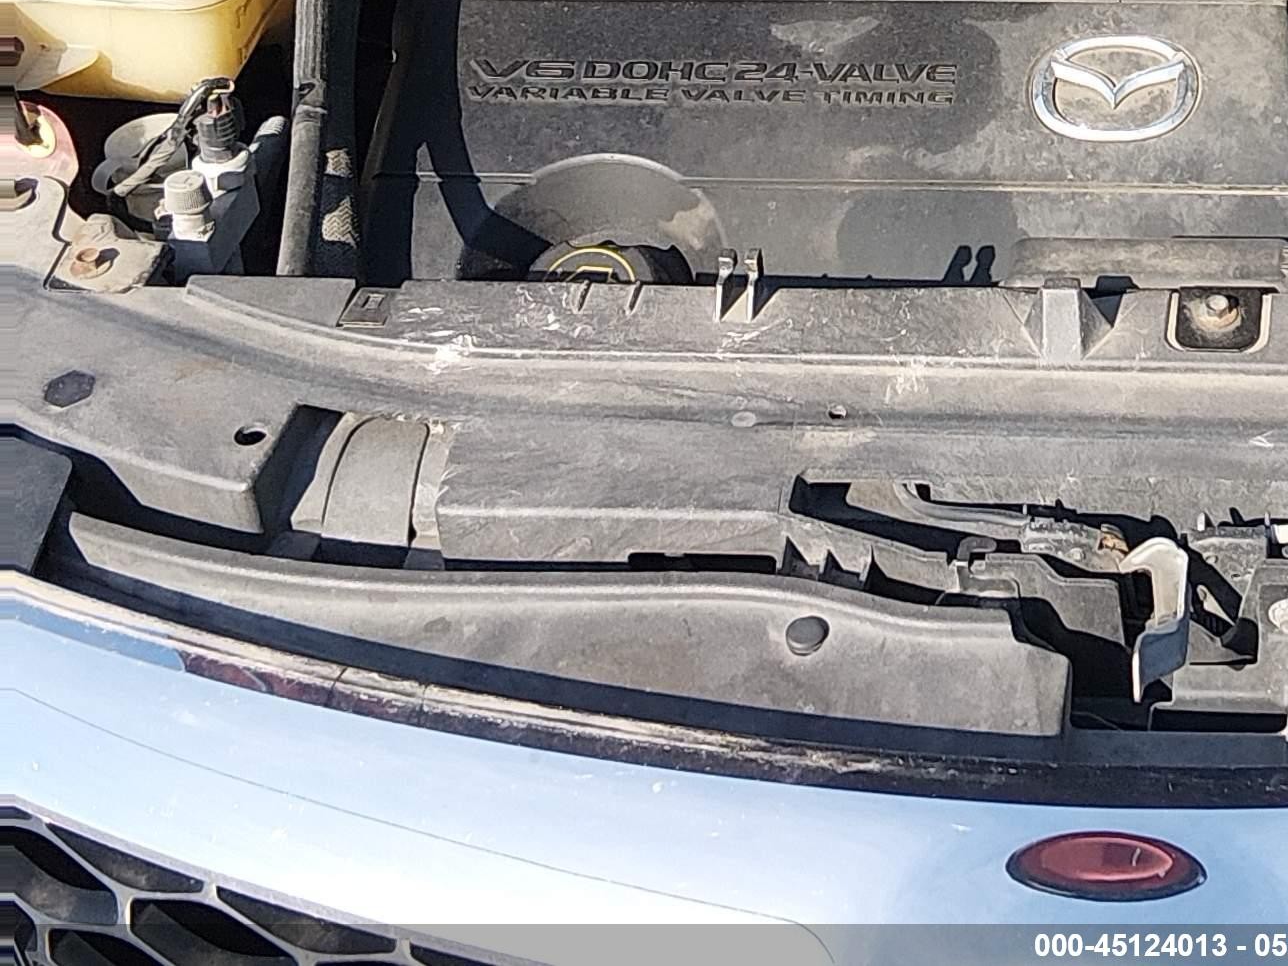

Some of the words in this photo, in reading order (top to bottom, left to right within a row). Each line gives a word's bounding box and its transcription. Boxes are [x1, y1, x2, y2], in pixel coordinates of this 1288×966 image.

[470, 59, 576, 80] V6
[581, 60, 729, 83] DOHC
[732, 61, 958, 85] 24-VALVE
[467, 85, 670, 102] VARIABLE
[680, 88, 806, 103] VALVE
[818, 90, 956, 106] TIMING
